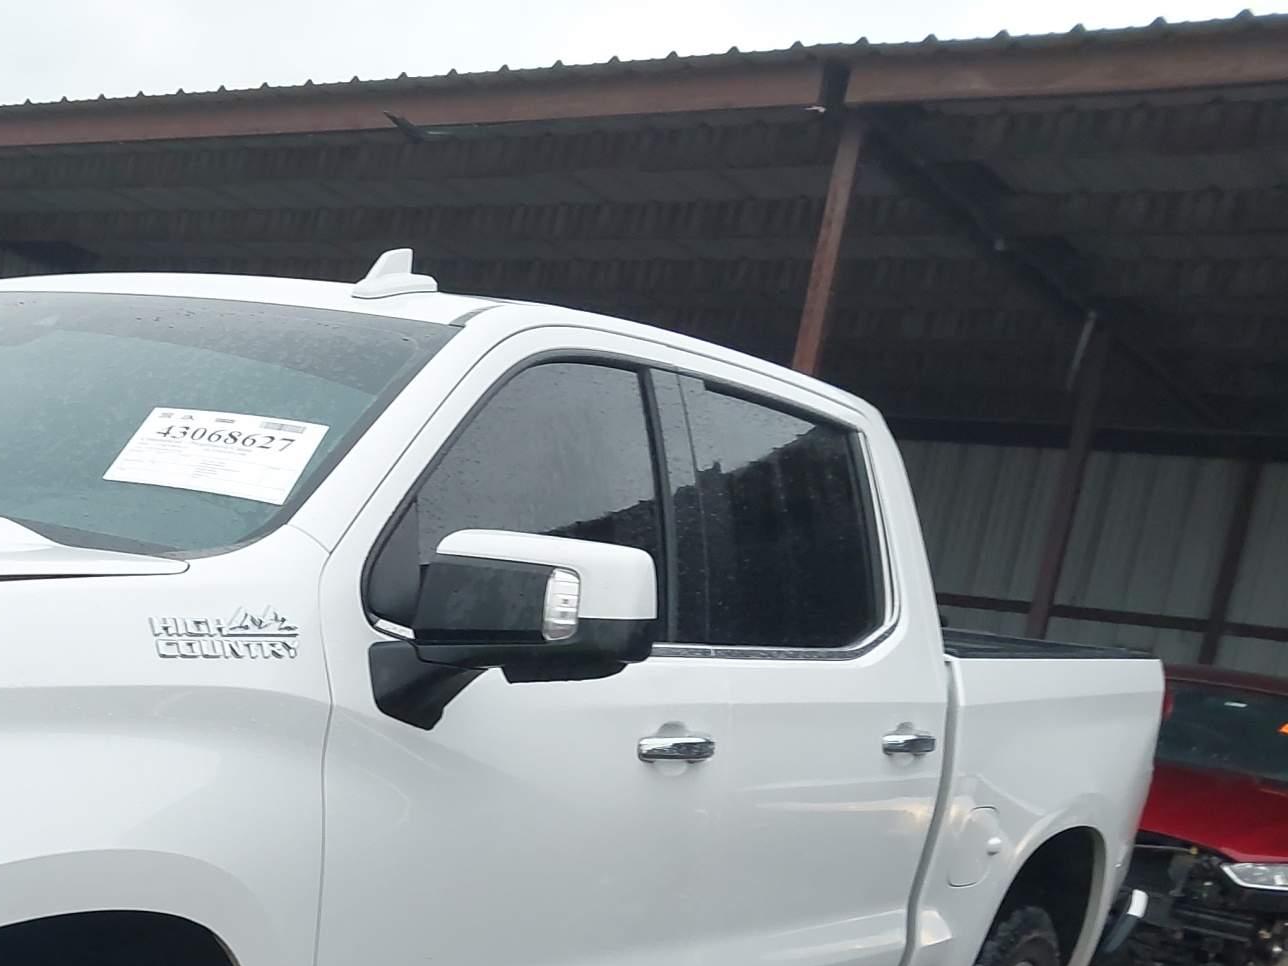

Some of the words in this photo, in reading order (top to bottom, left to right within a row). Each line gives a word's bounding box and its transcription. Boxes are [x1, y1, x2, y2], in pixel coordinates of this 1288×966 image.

[156, 424, 296, 452] 43068627
[148, 617, 230, 638] HIGH
[155, 638, 298, 659] COUNTRY
